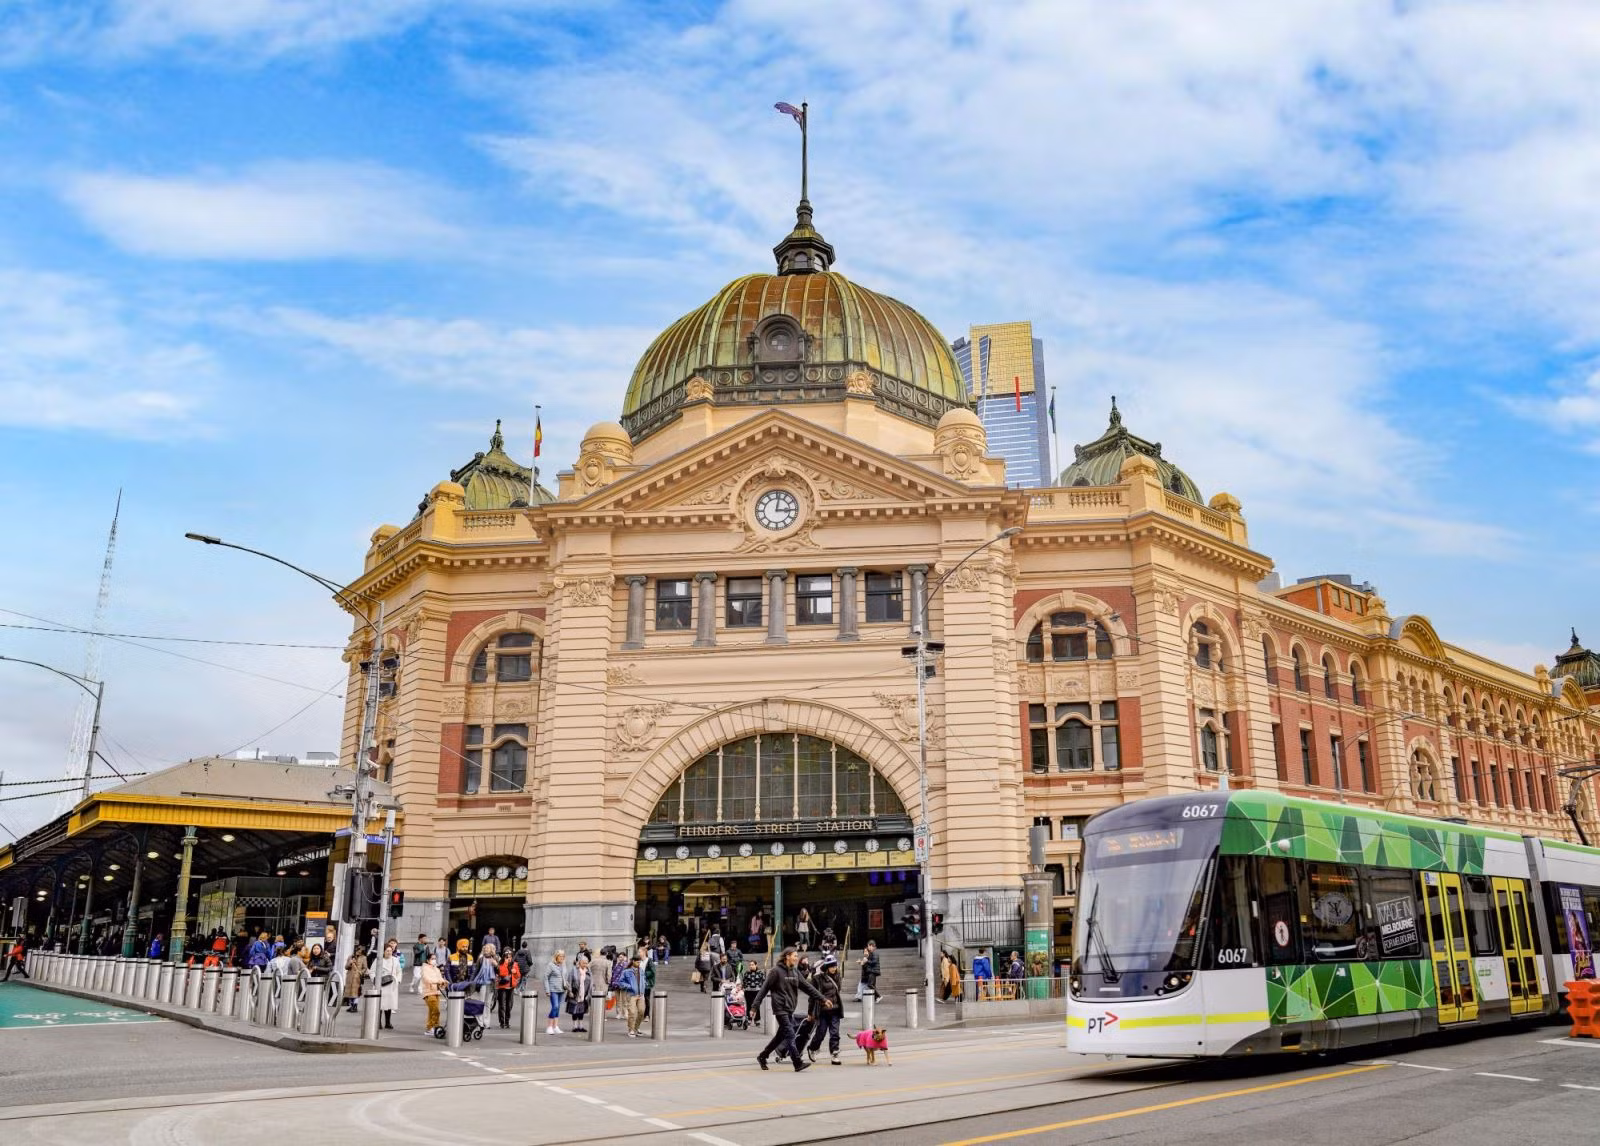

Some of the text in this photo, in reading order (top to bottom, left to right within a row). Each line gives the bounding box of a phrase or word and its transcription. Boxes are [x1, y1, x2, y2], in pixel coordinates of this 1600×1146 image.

[1182, 804, 1218, 818] 6067
[679, 820, 873, 836] FLINDERS STREET STATION
[1381, 917, 1414, 935] MELBOURNE
[1218, 948, 1247, 963] 6067
